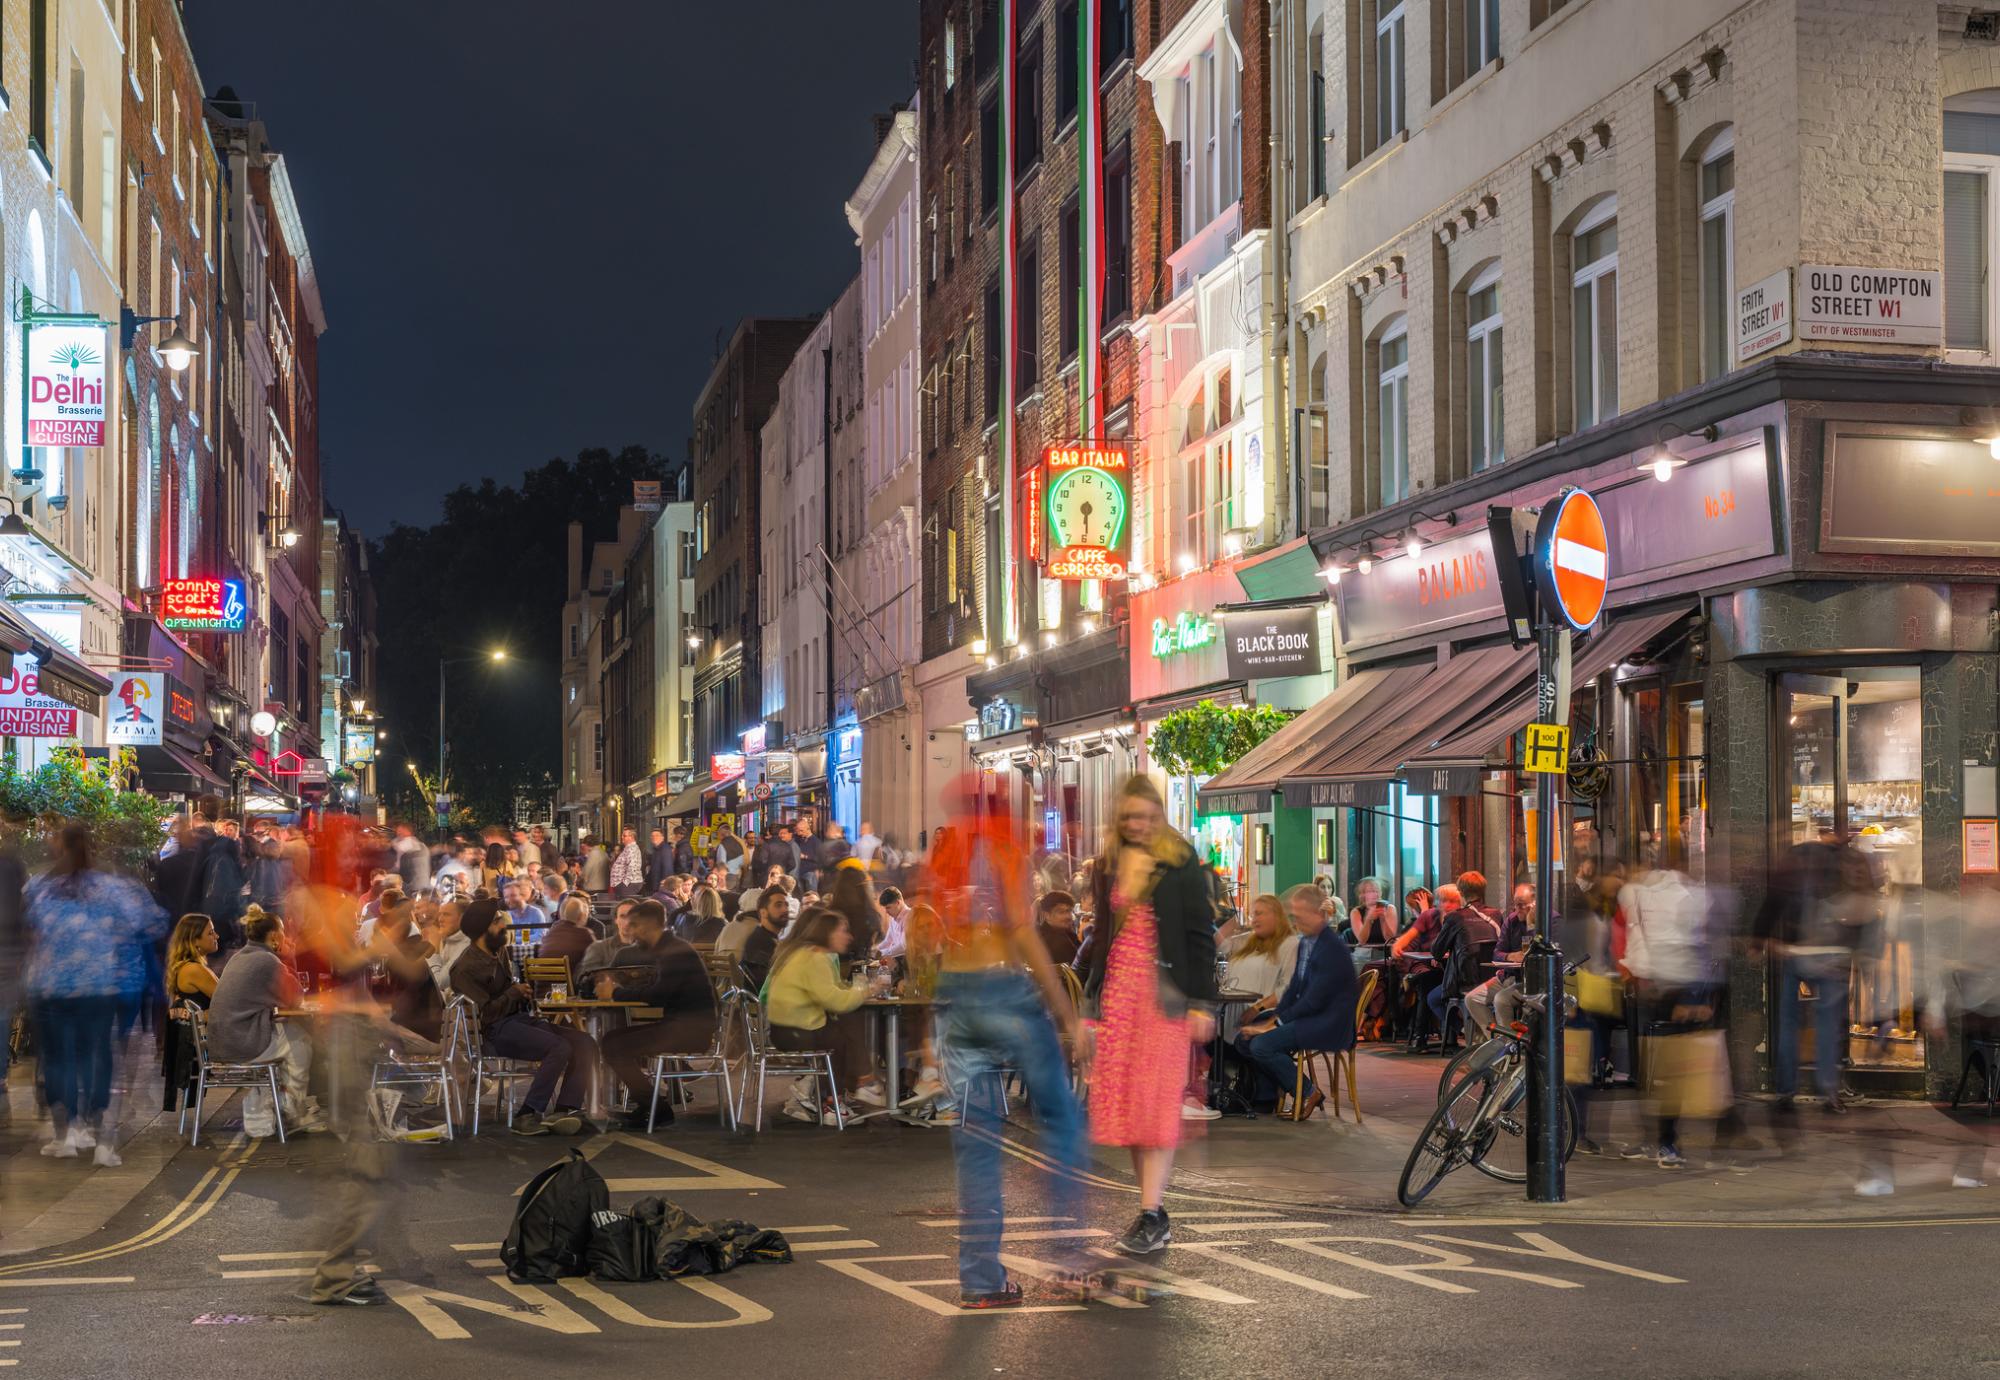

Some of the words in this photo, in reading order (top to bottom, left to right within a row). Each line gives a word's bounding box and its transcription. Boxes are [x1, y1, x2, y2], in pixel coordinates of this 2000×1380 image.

[1811, 272, 1842, 292] OLD
[1851, 274, 1931, 297] COMPTON
[1741, 287, 1763, 314] FRITH
[1811, 296, 1872, 317] STREET
[1878, 299, 1901, 318] W1
[1742, 307, 1769, 336] STREET
[1772, 301, 1784, 321] W1
[1811, 325, 1827, 334] CITY
[1831, 326, 1840, 335] OF
[1842, 326, 1896, 337] WESTMINSTER
[56, 373, 69, 382] The
[31, 376, 102, 404] Delhi
[57, 405, 102, 415] Brasserie
[35, 421, 98, 433] INDIAN
[35, 433, 98, 444] CUISINE
[1051, 450, 1079, 465] BAR
[1083, 451, 1125, 466] ITALIA
[1082, 475, 1092, 484] 12
[1100, 481, 1103, 489] 1
[1060, 489, 1069, 498] 10
[1106, 492, 1113, 500] 2
[1056, 504, 1062, 512] 9
[1110, 506, 1116, 515] 3
[1060, 519, 1066, 527] 8
[1104, 521, 1111, 530] 4
[1065, 533, 1072, 542] 7
[1081, 534, 1087, 543] 6
[1099, 535, 1105, 544] 5
[1068, 549, 1107, 562] CAFFE
[1052, 563, 1123, 577] ESPRESSO
[1418, 550, 1487, 607] BALANS
[167, 581, 220, 592] ronnie
[167, 593, 219, 603] scott's
[165, 618, 196, 628] OPEN
[197, 618, 242, 628] NIGHTLY
[1265, 626, 1277, 635] THE
[1152, 617, 1172, 657] Bar
[1237, 635, 1275, 653] BLACK
[1278, 633, 1309, 650] BOOK
[0, 710, 69, 723] INDIAN
[0, 723, 69, 735] CUISINE
[112, 726, 156, 735] ZIMA
[757, 786, 769, 796] 20
[1320, 784, 1330, 803] DAY
[817, 1232, 1688, 1316] ENTRY
